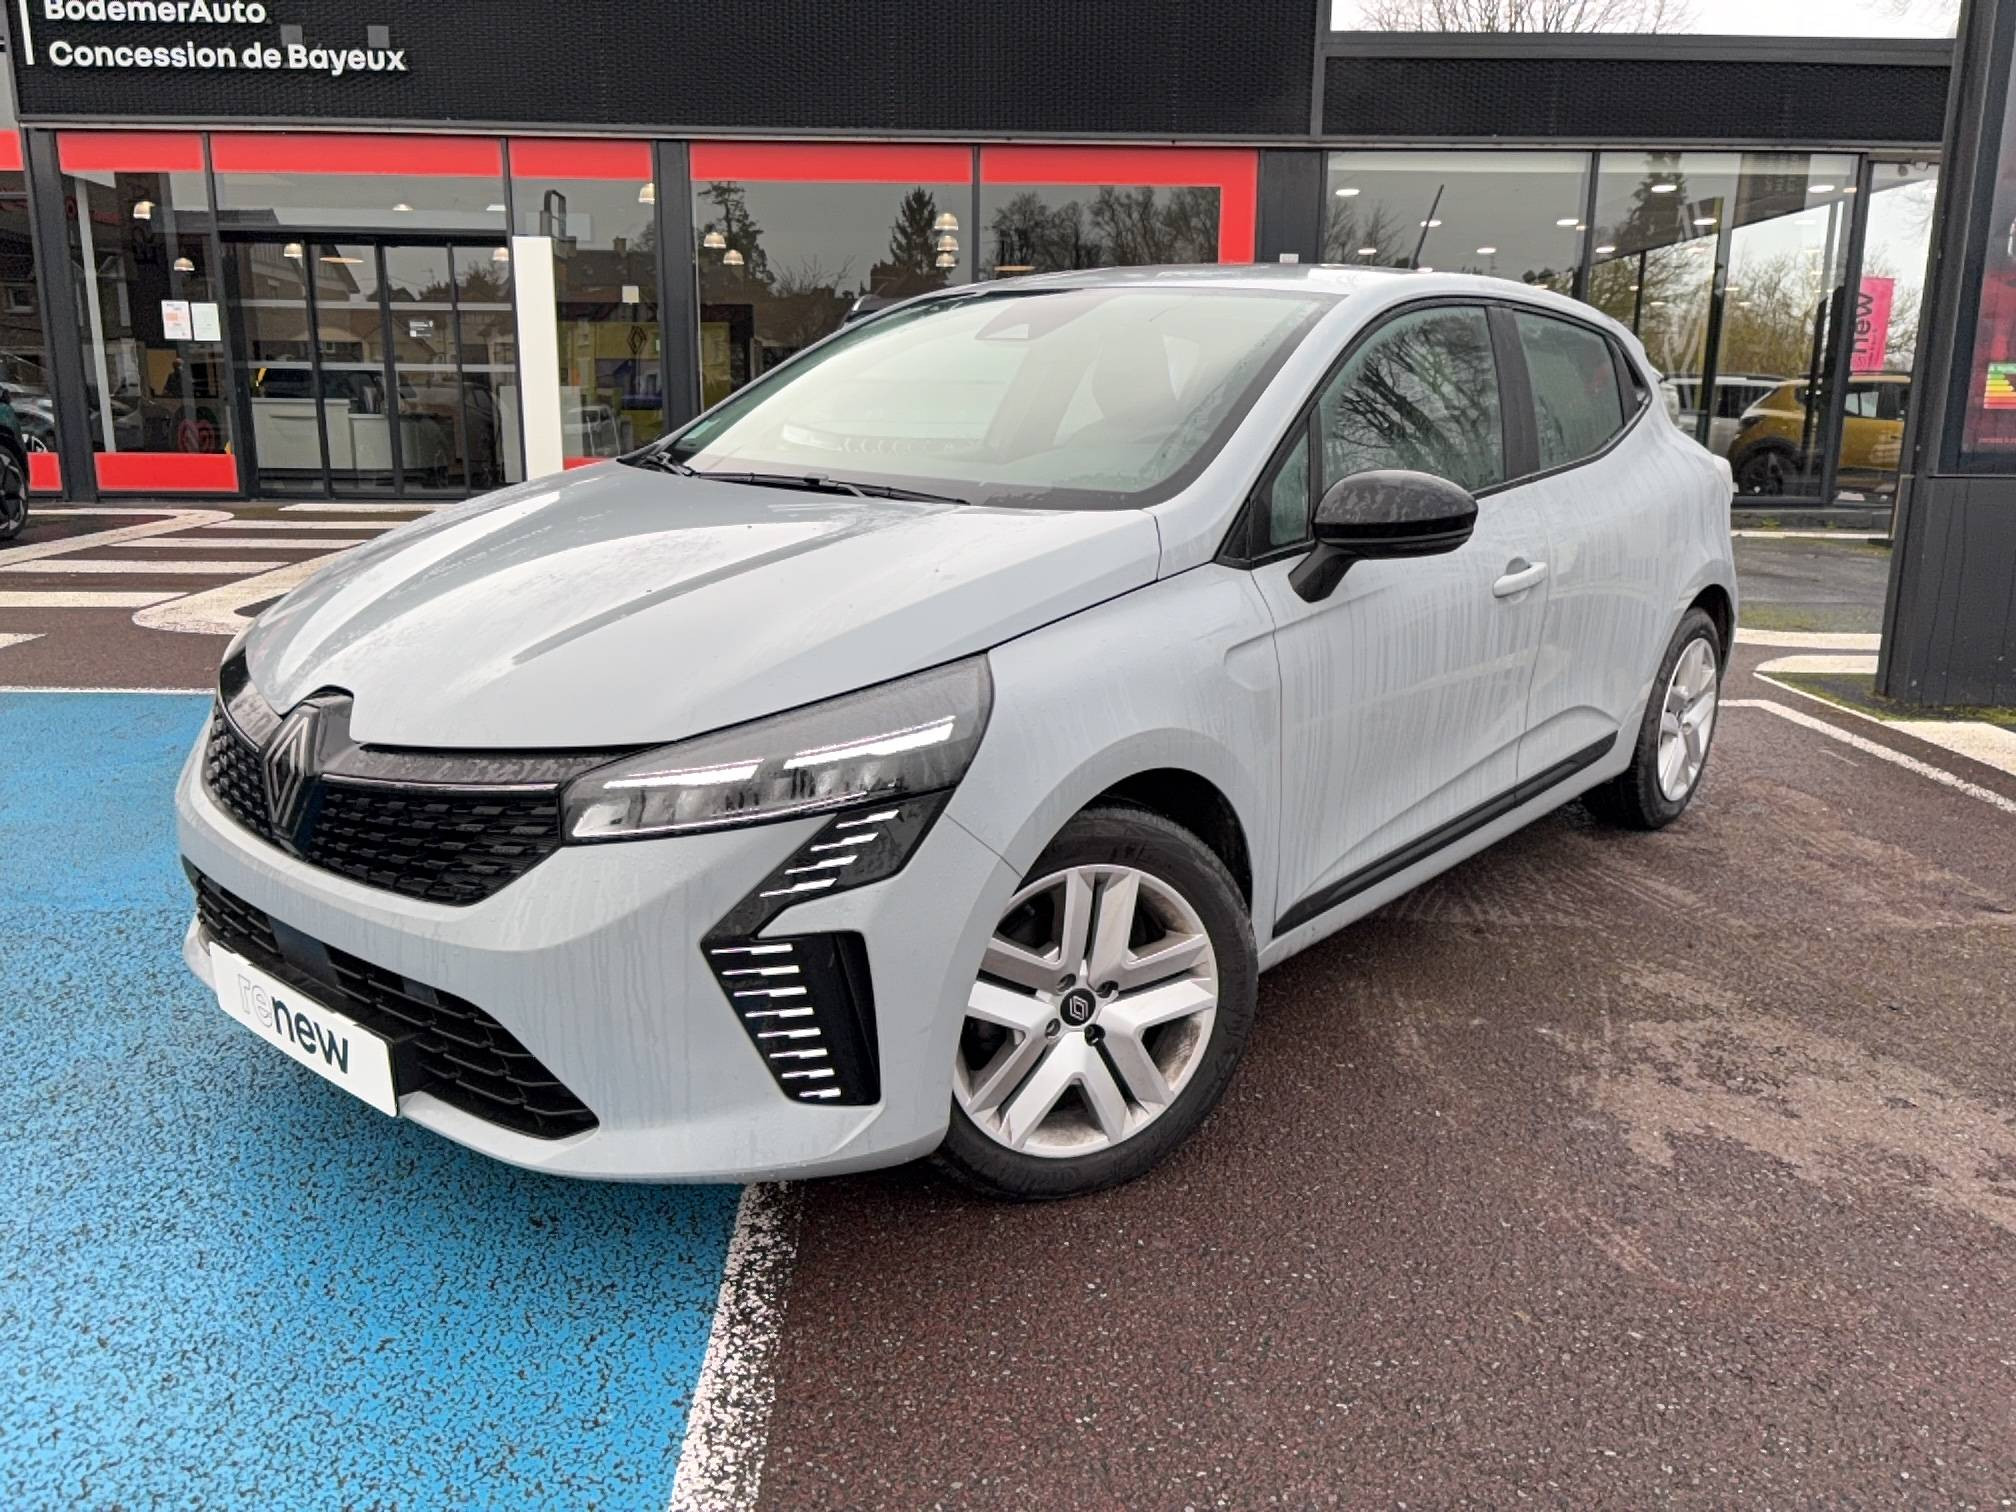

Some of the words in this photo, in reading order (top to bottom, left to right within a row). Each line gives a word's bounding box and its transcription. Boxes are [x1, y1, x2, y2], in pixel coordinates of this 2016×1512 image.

[44, 0, 267, 24] BodemerAuto
[48, 40, 237, 69] Concession
[242, 41, 282, 69] de
[287, 43, 407, 77] Bayeux
[237, 973, 349, 1075] renew
